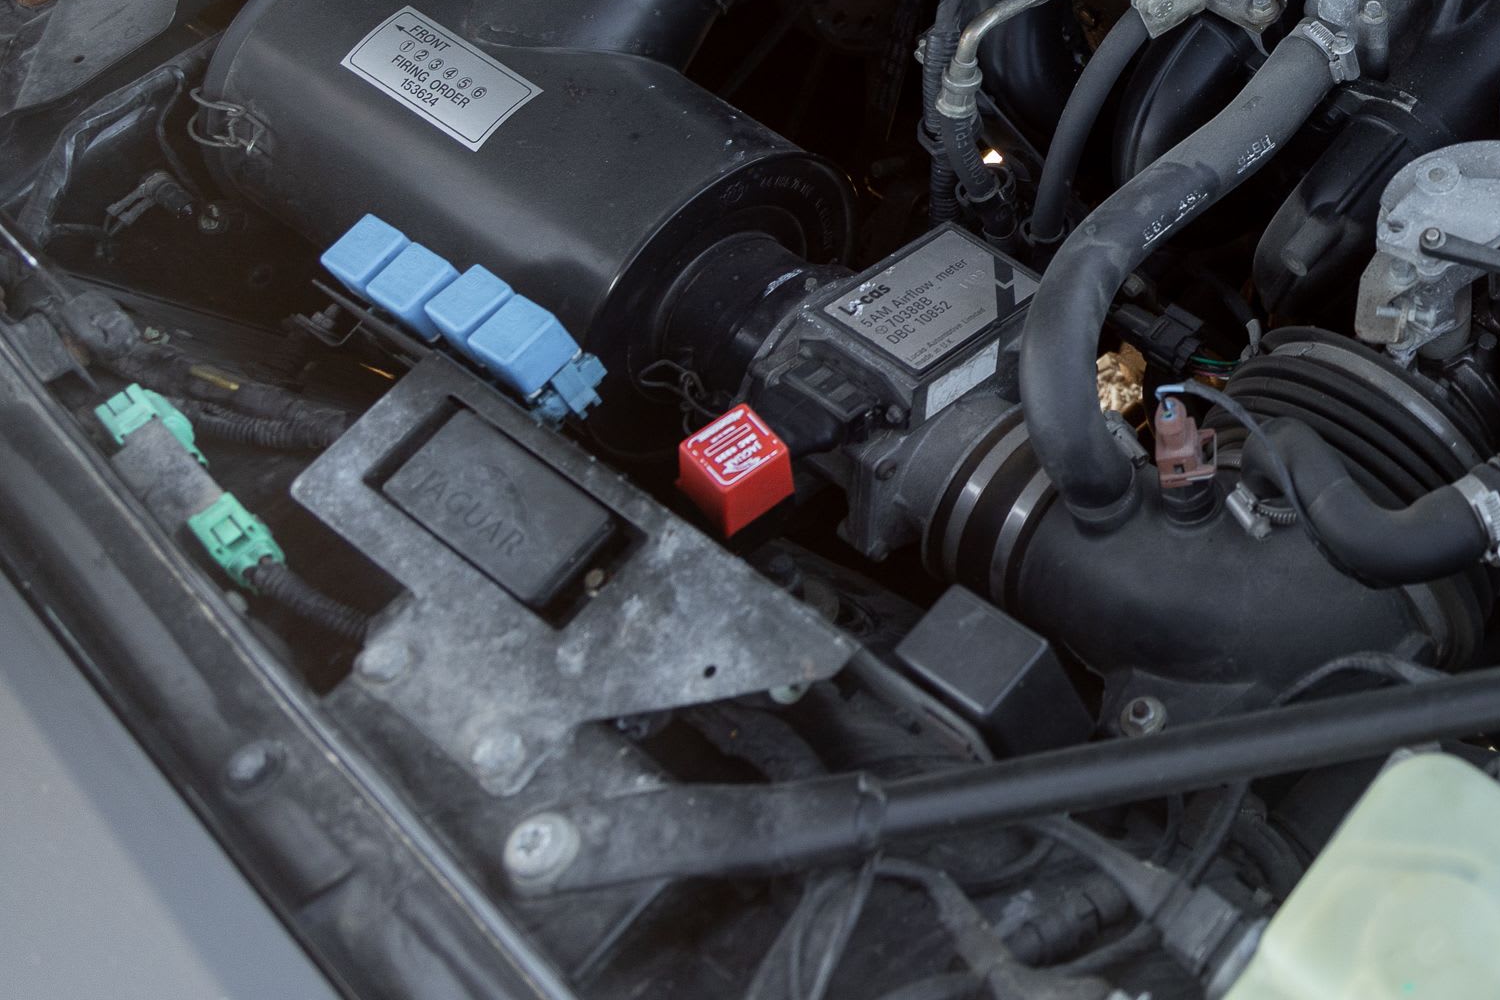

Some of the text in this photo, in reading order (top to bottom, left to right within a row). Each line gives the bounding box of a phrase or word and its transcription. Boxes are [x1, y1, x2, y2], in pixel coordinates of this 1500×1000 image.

[409, 25, 451, 52] FRONT
[391, 54, 471, 108] FIRING ORDER
[400, 78, 439, 107] 153624
[893, 279, 934, 308] Airflow
[936, 258, 968, 282] meter
[886, 300, 953, 346] DBC 10852
[408, 469, 525, 557] JAGUAR
